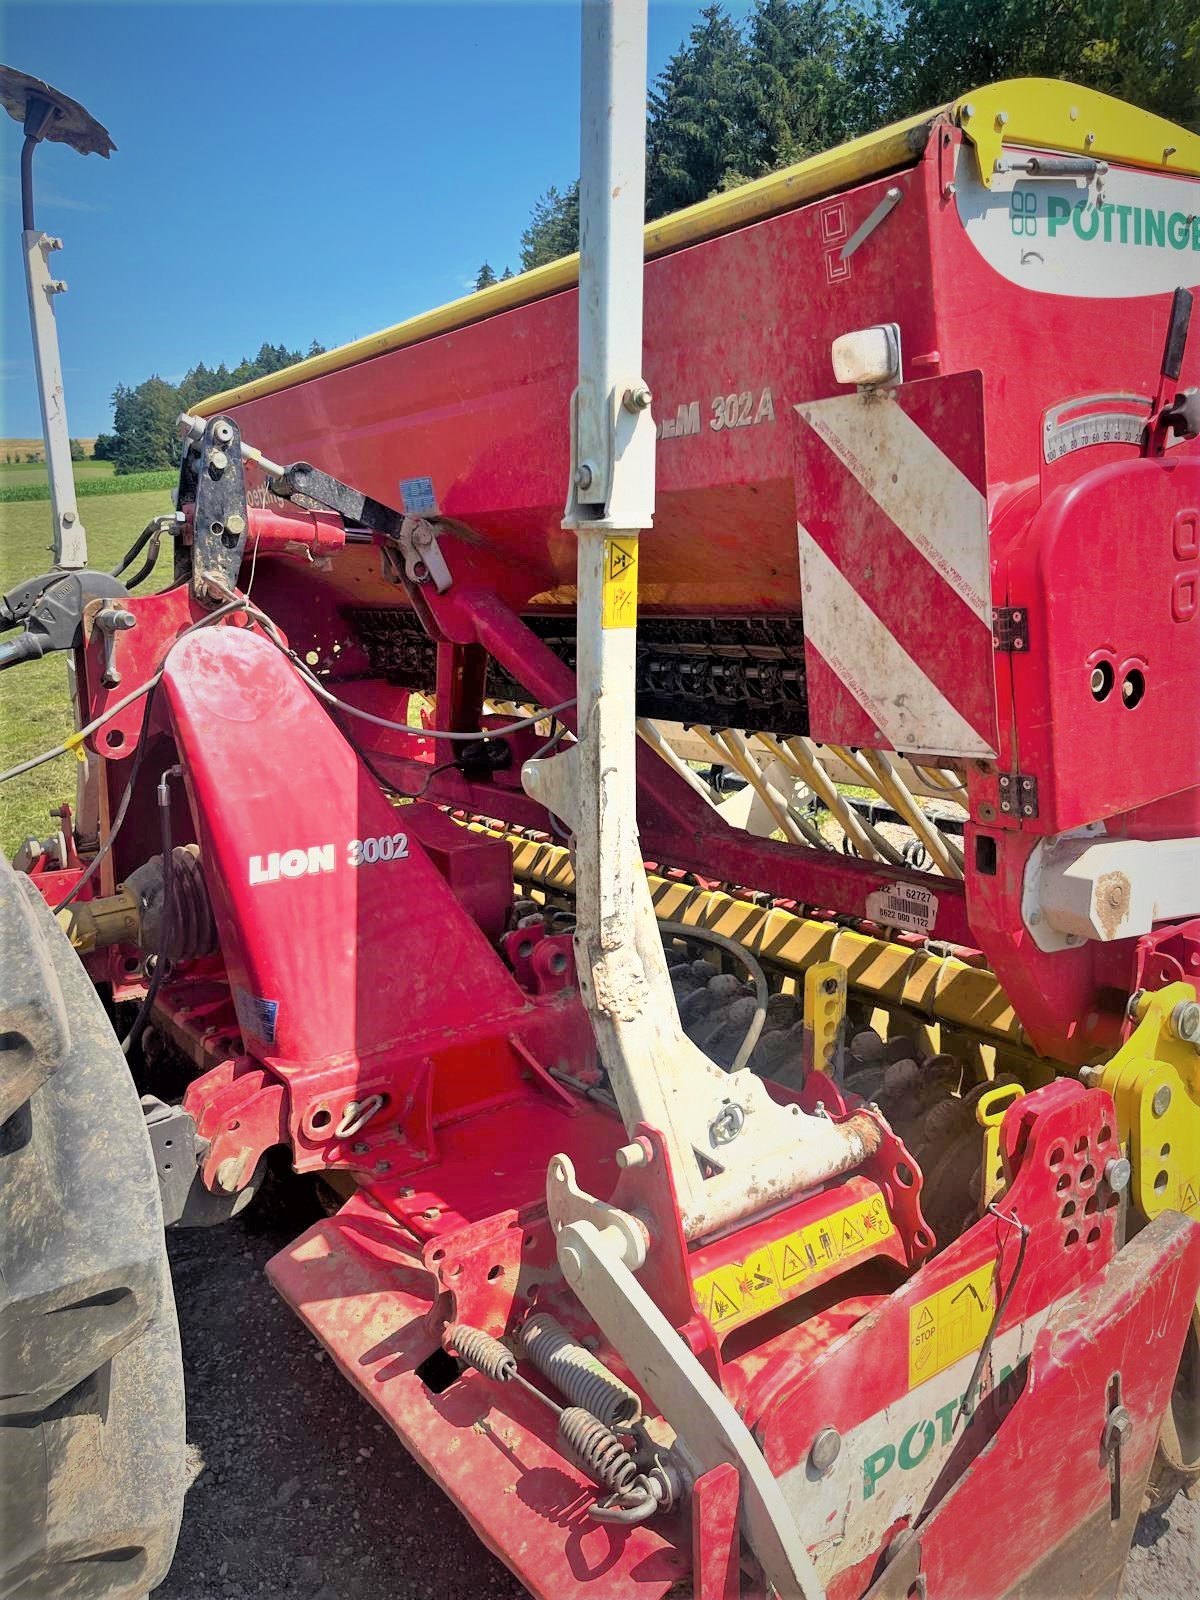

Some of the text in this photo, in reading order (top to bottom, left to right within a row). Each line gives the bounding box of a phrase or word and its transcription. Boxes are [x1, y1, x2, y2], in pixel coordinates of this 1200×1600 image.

[1058, 443, 1067, 455] 90
[1070, 438, 1078, 450] 80
[1081, 434, 1089, 445] 70
[1092, 432, 1100, 443] 60
[1103, 430, 1111, 441] 50
[1113, 431, 1121, 441] 40
[1124, 431, 1132, 441] 30
[249, 832, 409, 886] LION 3002
[906, 888, 931, 903] 62727
[897, 913, 910, 923] 000
[913, 916, 929, 928] 1122
[915, 1326, 936, 1346] STOP
